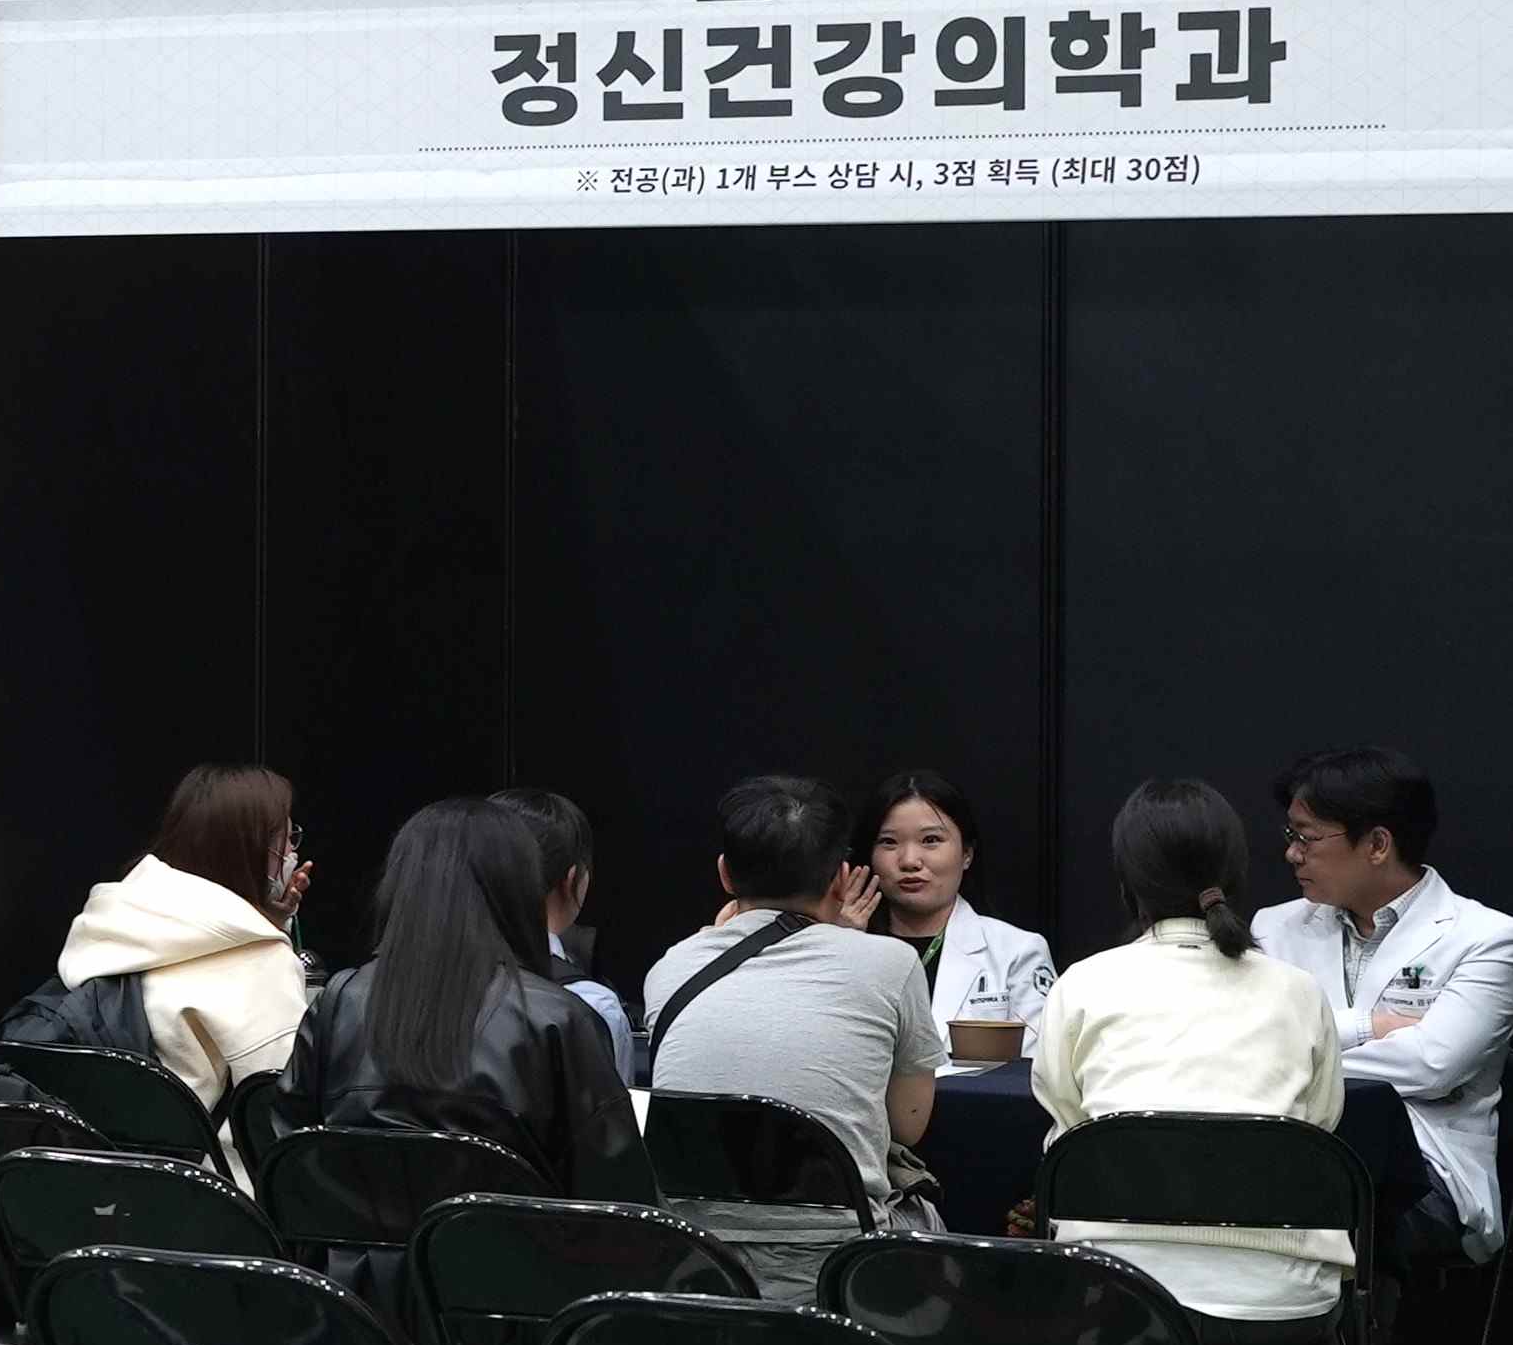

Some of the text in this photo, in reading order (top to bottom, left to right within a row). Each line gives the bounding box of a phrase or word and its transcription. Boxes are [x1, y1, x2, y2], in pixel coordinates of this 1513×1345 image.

[491, 7, 1286, 127] 정신건강의학과
[611, 166, 704, 195] 전공(과)
[717, 165, 756, 191] 1개
[767, 165, 816, 190] 부스
[828, 162, 879, 189] 상담
[890, 161, 922, 191] 시,
[934, 160, 975, 186] 3점
[988, 159, 1039, 185] 획득
[1052, 157, 1115, 187] (최대
[1127, 155, 1199, 185] 30점)
